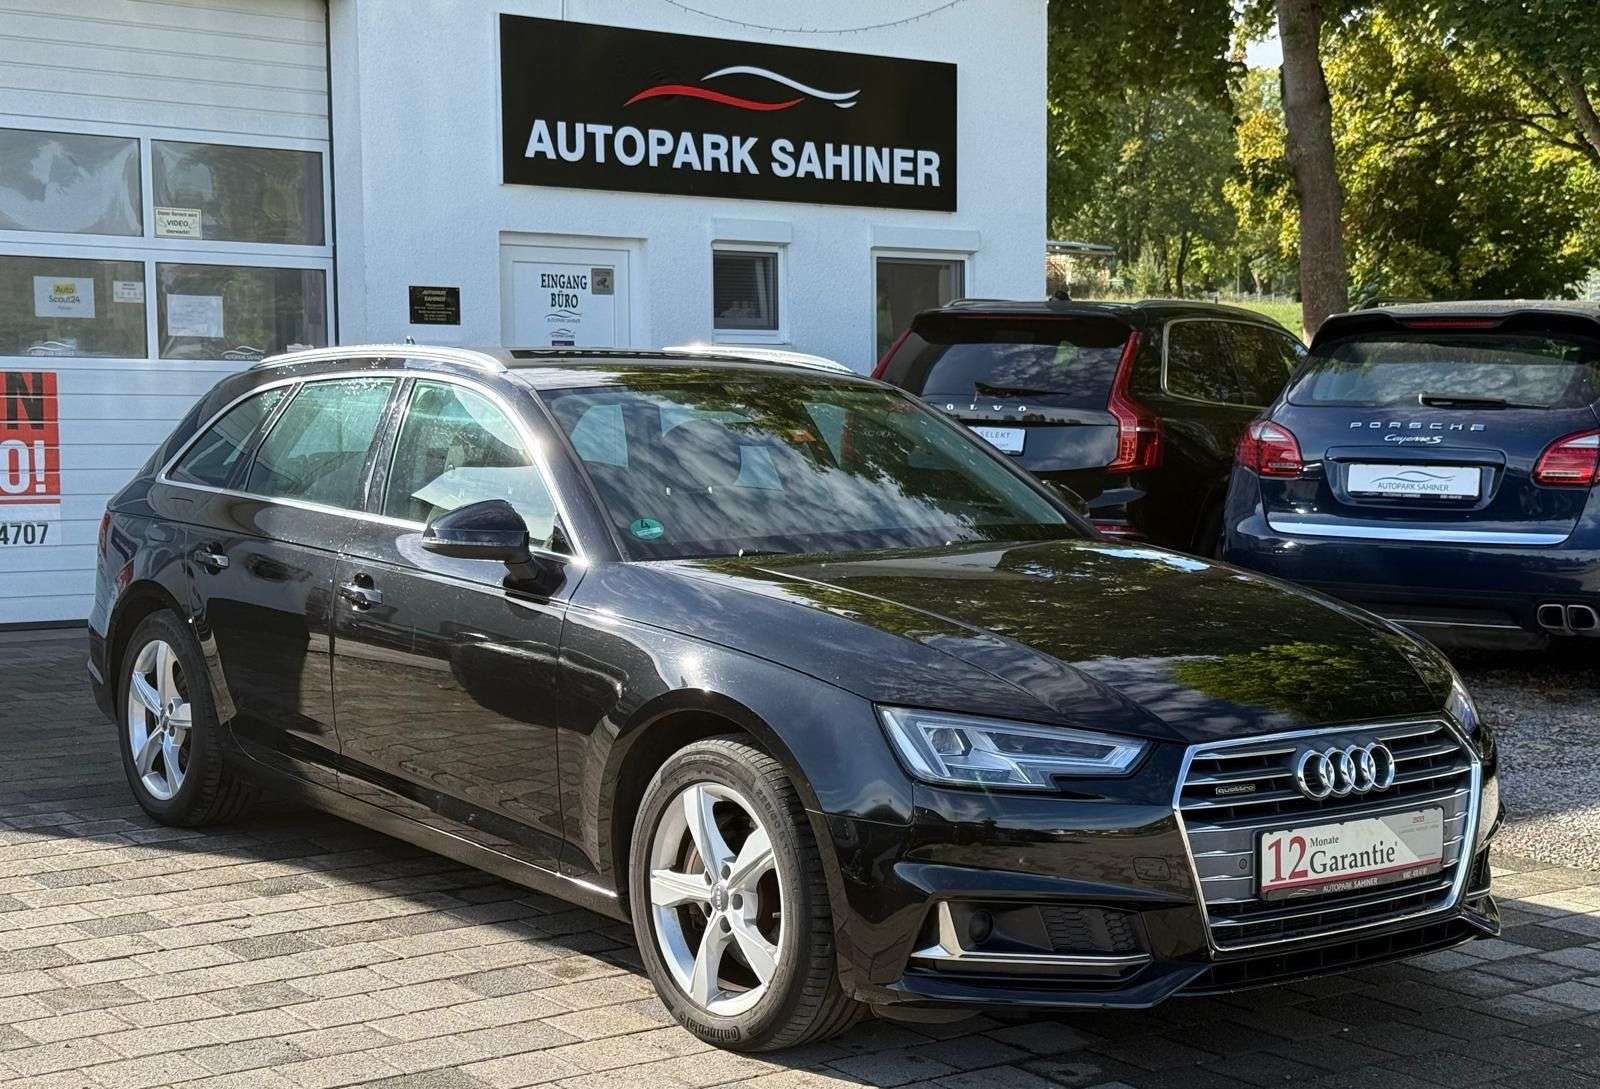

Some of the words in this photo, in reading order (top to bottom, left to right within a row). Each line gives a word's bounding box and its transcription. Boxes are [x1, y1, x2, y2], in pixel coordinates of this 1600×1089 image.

[524, 119, 760, 175] AUTOPARK
[771, 139, 941, 187] SAHINER
[167, 219, 189, 227] VIDEO
[541, 273, 588, 290] EINGANG
[54, 285, 74, 295] Auto
[48, 295, 80, 304] Scout24
[550, 290, 579, 309] BÜRO
[1350, 421, 1487, 431] PORSCHE
[1377, 482, 1415, 490] AUTOPARK
[1416, 484, 1449, 492] SAHINER
[0, 523, 49, 545] 4707
[1217, 784, 1255, 795] quattro
[1267, 835, 1309, 882] 12
[1310, 836, 1340, 847] Monate
